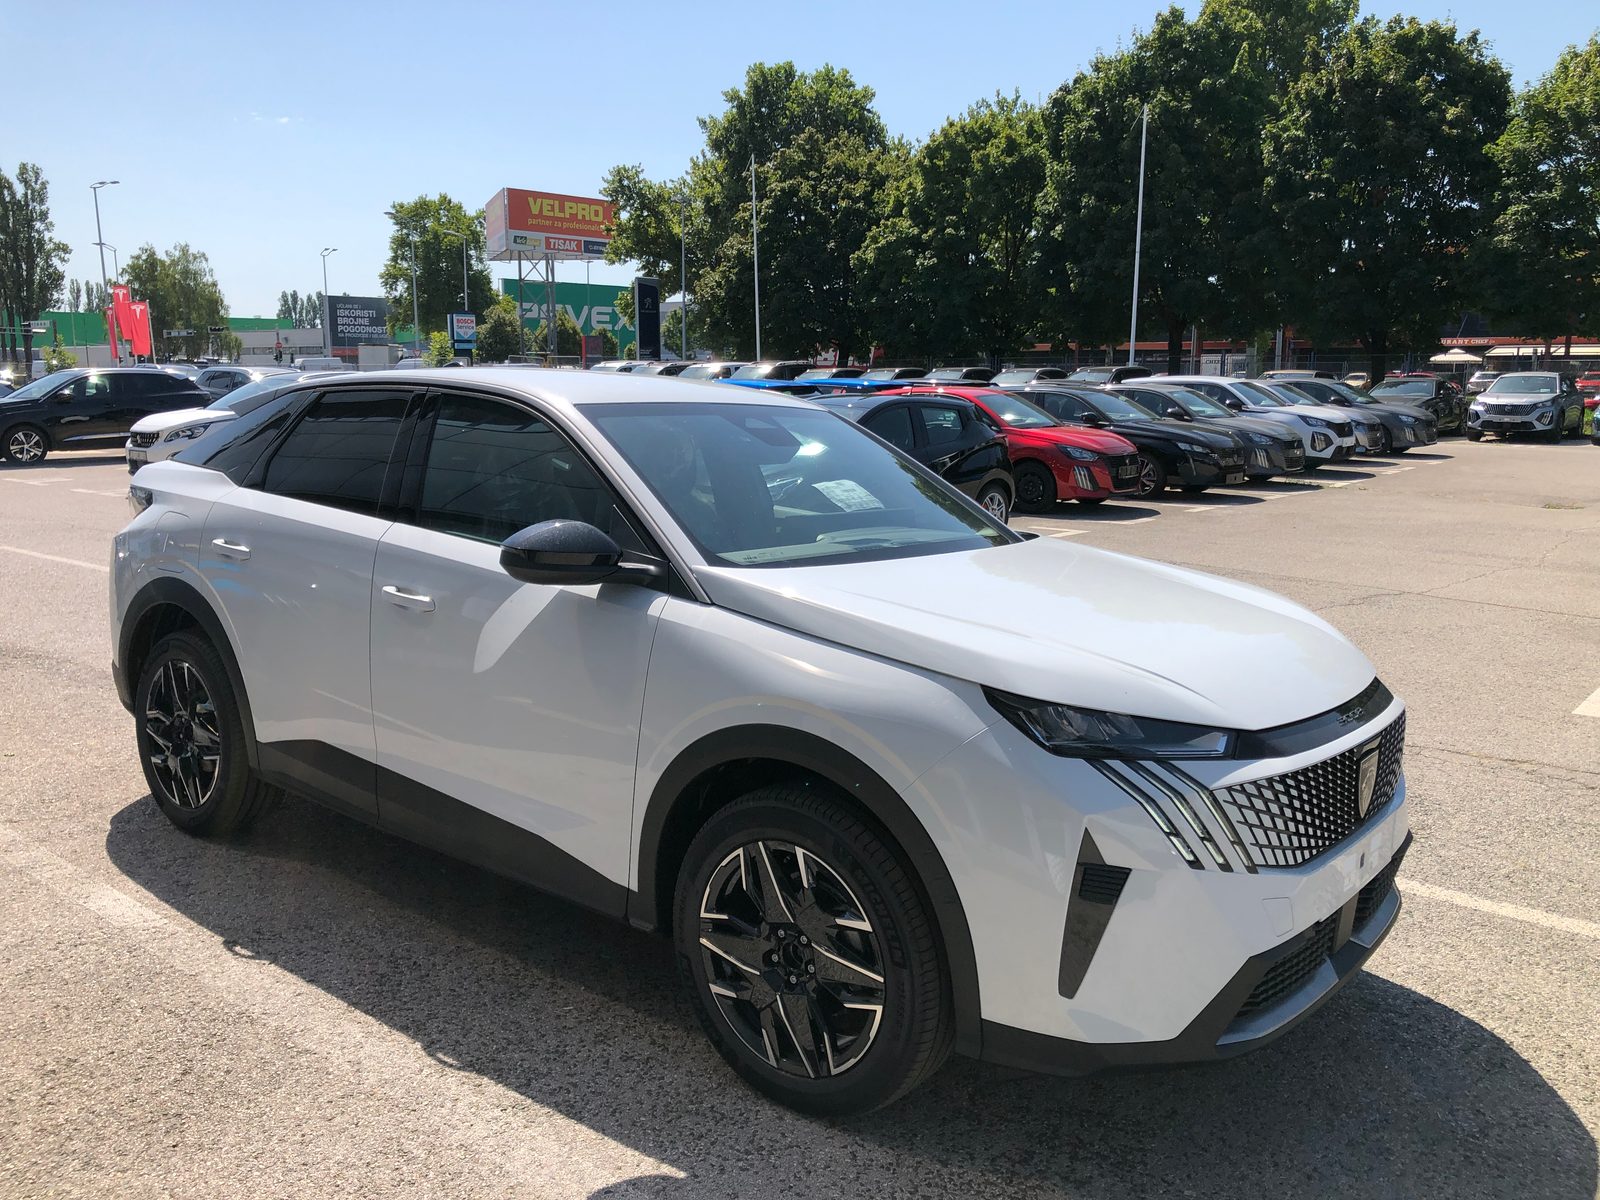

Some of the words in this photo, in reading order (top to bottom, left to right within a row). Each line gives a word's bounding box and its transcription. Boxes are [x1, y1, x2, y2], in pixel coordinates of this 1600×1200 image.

[527, 196, 603, 222] VELPRO
[527, 217, 552, 226] partner
[554, 220, 562, 228] za
[549, 239, 578, 251] TISAK
[336, 309, 376, 318] ISKORISTI
[337, 317, 370, 325] BROJNE
[338, 325, 386, 334] POGODNOST
